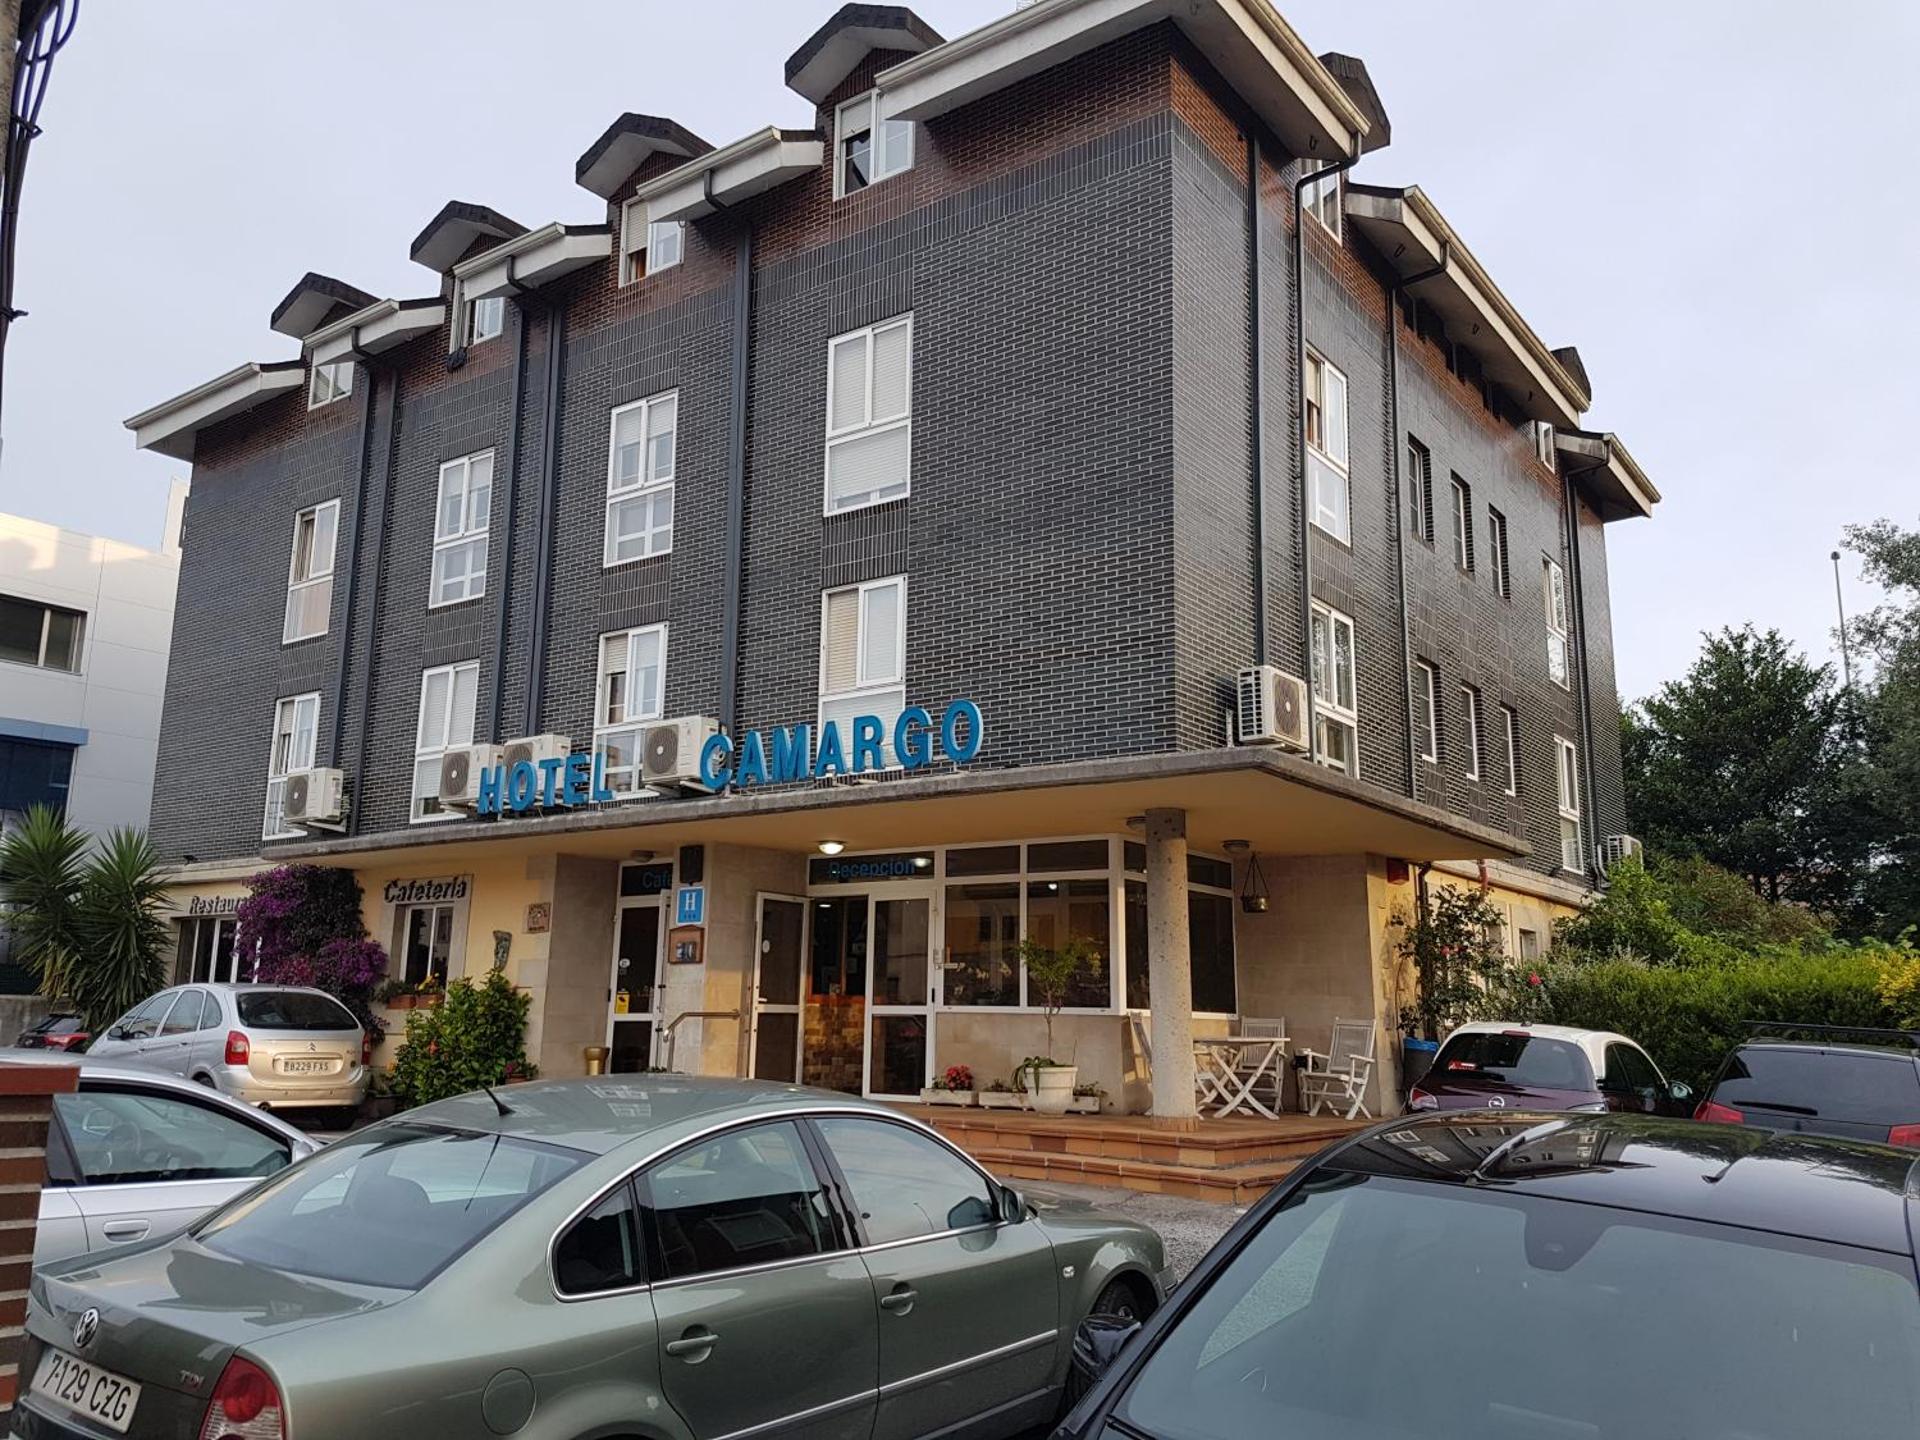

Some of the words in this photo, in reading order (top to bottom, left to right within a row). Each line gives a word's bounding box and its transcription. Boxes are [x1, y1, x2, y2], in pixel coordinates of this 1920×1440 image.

[477, 751, 616, 814] HOTEL
[700, 698, 985, 792] CAMARGO
[685, 892, 697, 911] H
[42, 1353, 90, 1403] 7129
[89, 1376, 132, 1422] CZG
[179, 1369, 205, 1389] TDI
